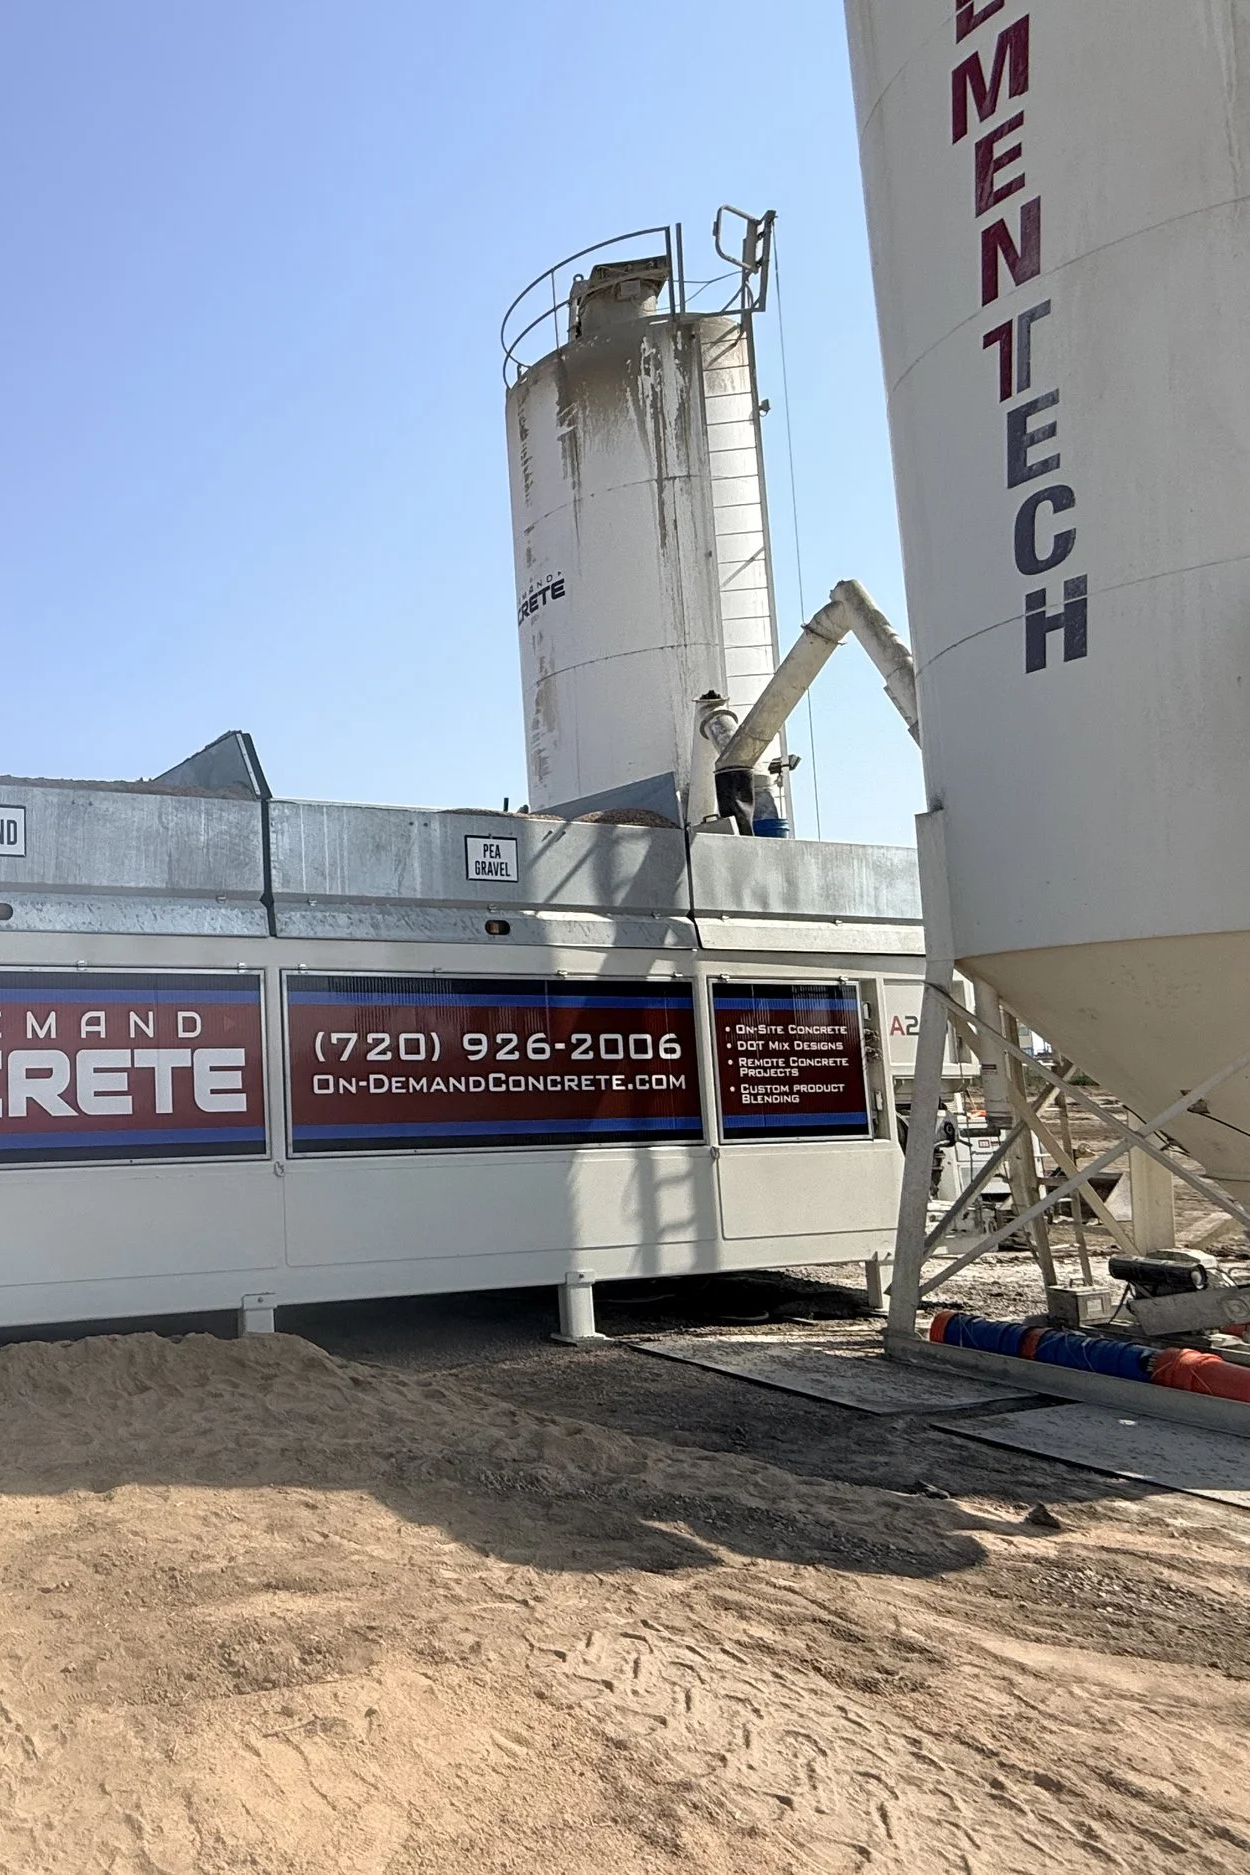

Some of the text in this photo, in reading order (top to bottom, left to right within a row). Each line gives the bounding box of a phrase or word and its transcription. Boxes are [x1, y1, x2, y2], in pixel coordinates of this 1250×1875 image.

[483, 844, 501, 859] PEA
[474, 860, 511, 877] GRAVEL
[314, 1031, 682, 1062] (720) 926-2006
[737, 1041, 765, 1051] DOT
